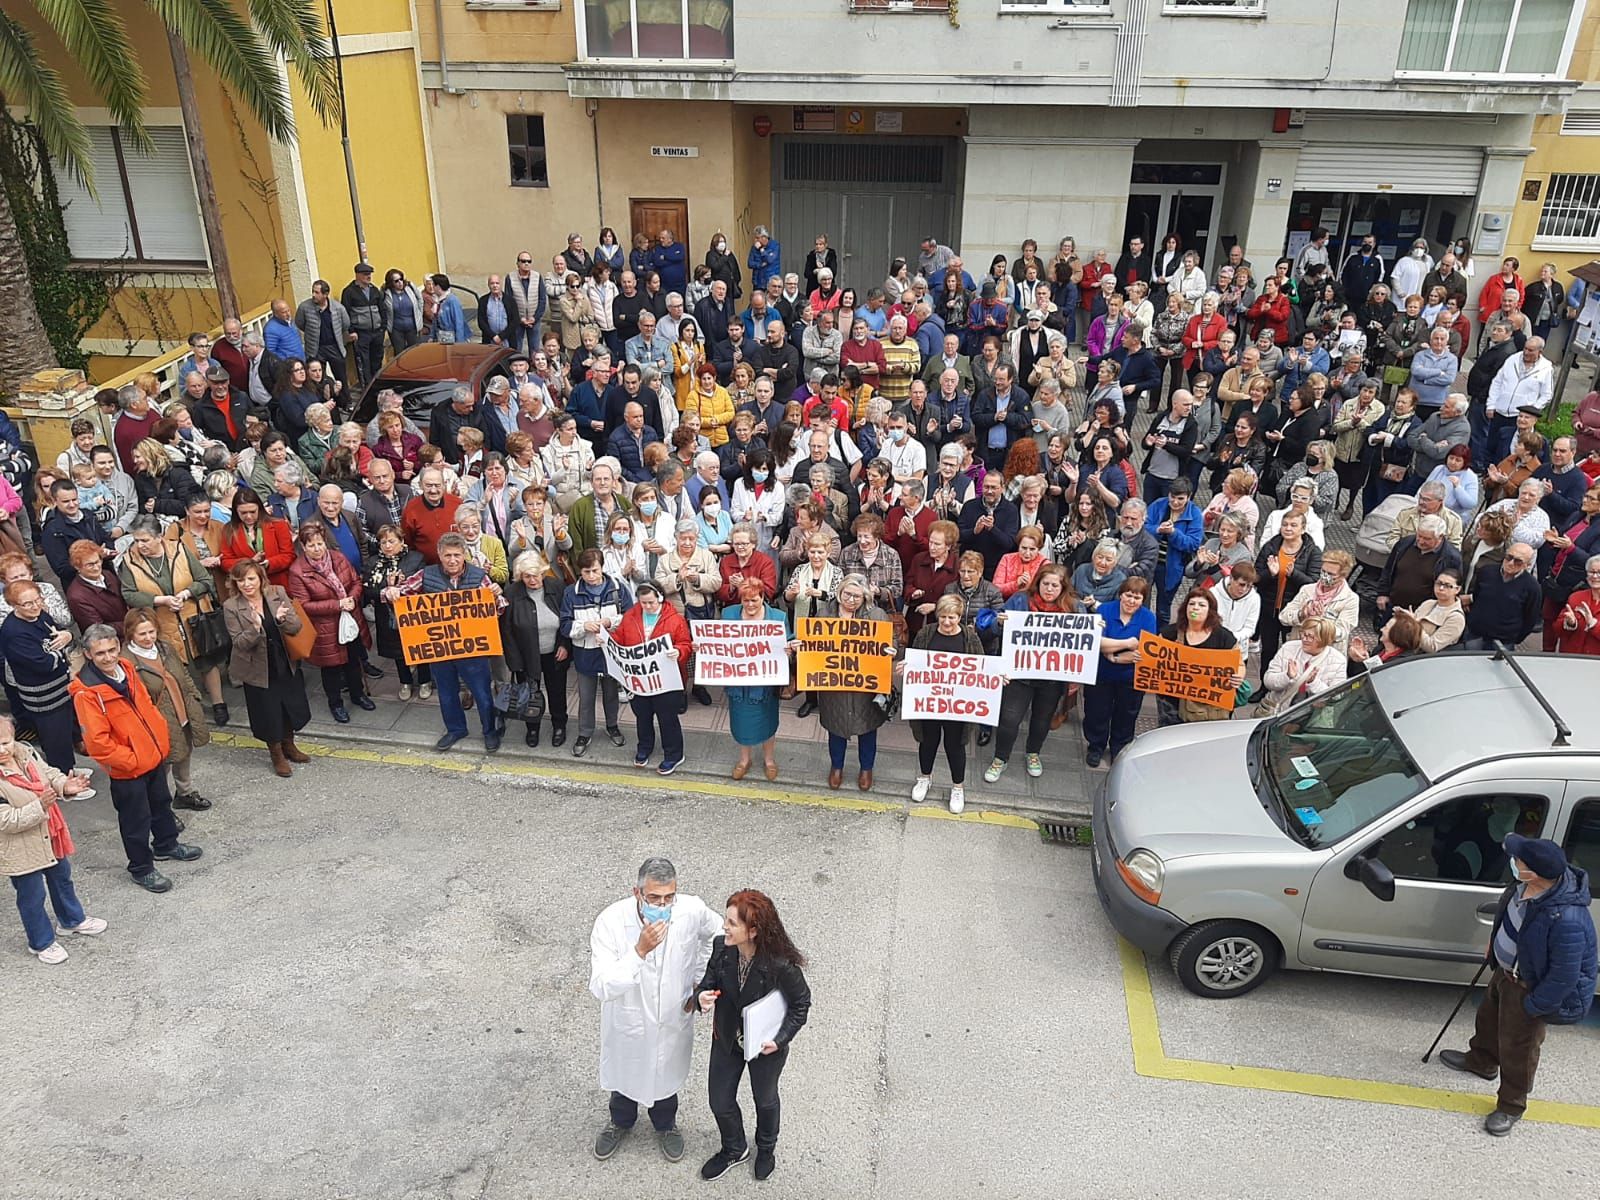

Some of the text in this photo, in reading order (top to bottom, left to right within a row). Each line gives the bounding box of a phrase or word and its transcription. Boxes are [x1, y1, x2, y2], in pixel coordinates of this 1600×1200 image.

[652, 147, 689, 156] DE VENTAS
[399, 602, 496, 627] AMBULATORIO
[1024, 614, 1095, 630] ATENCION
[426, 622, 461, 641] SIN
[695, 624, 784, 638] NECESITAMOS
[1011, 630, 1095, 651] PRIMARIA
[408, 636, 490, 661] MEDICOS
[607, 636, 669, 660] ATENCION
[700, 641, 772, 658] ATENCION
[1143, 641, 1179, 661] CON
[825, 655, 859, 672] SIN
[1157, 660, 1235, 678] NUESTRA
[807, 672, 878, 690] MEDICOS
[906, 670, 1000, 690] AMBULATORIO
[1138, 666, 1233, 691] SALUD NO
[931, 685, 954, 696] SIN
[1136, 677, 1223, 703] SE JUEGA
[914, 697, 990, 717] MEDICOS
